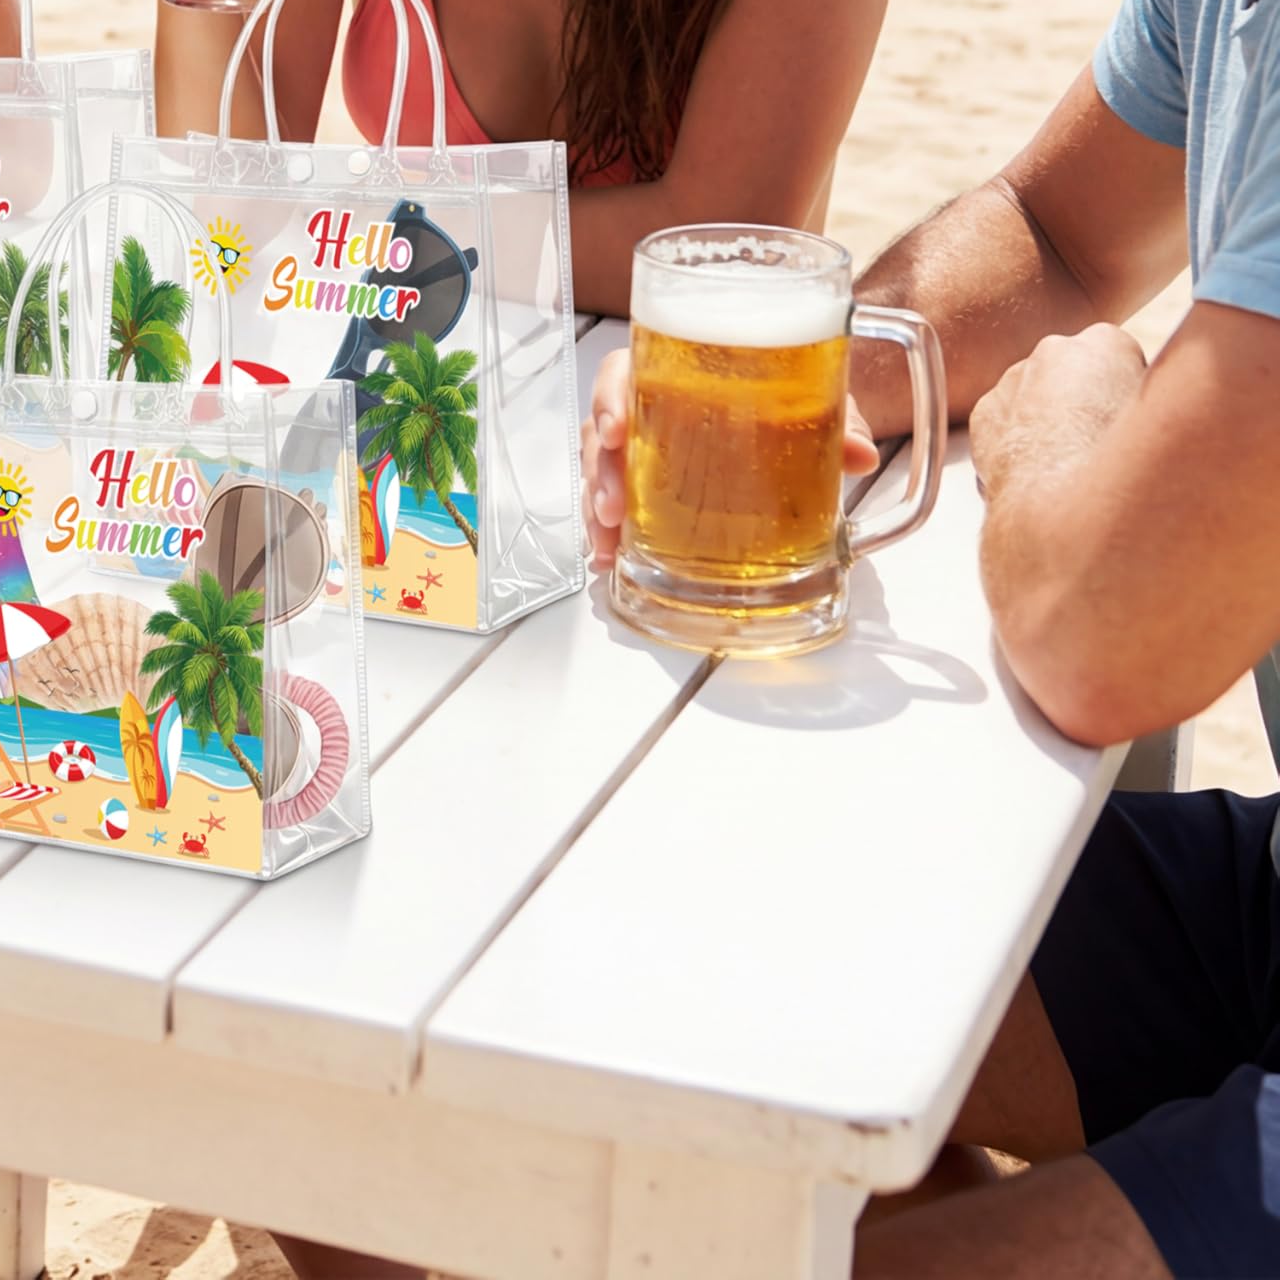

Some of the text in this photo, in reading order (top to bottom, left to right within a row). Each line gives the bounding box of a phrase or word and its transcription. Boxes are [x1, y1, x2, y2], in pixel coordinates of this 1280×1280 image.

[307, 211, 410, 269] Hello
[264, 256, 418, 320] Summer
[90, 449, 196, 508] Hello
[45, 497, 203, 558] Summer
